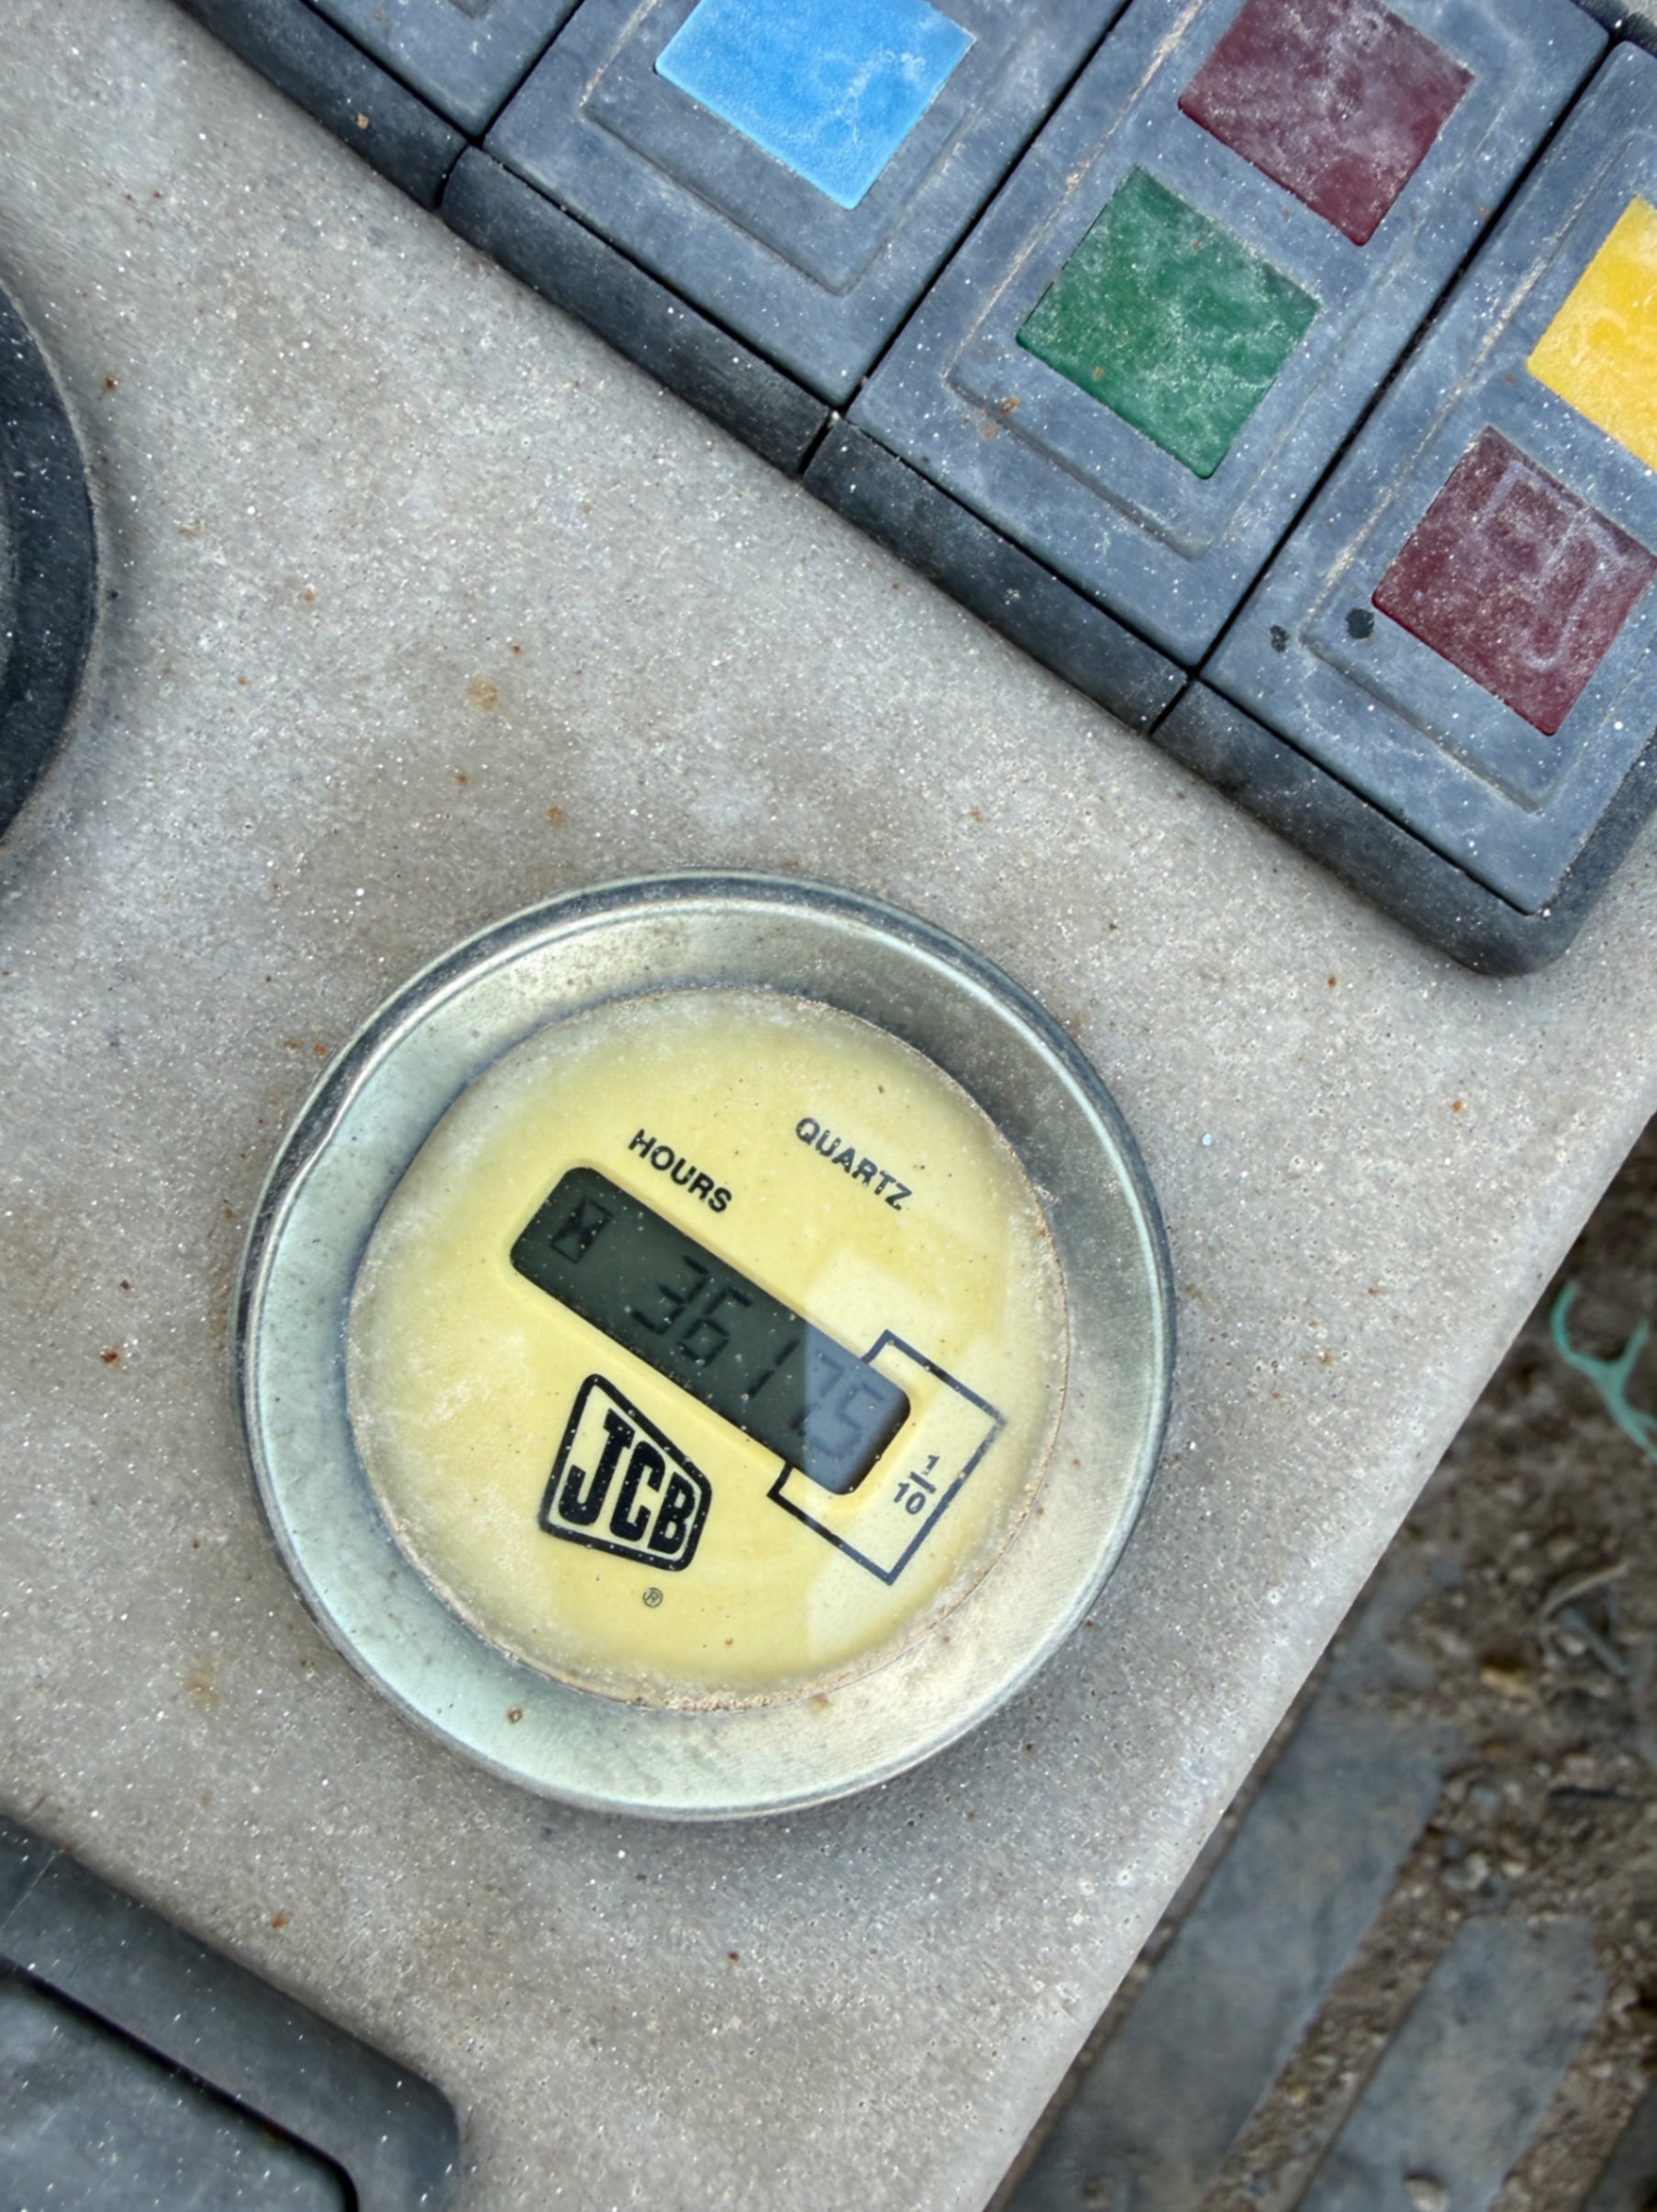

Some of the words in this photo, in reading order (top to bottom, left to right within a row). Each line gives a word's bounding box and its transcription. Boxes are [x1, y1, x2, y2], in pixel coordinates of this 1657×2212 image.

[628, 1128, 733, 1214] HOURS
[795, 1117, 914, 1211] QUARTZ
[558, 1406, 695, 1555] JCB
